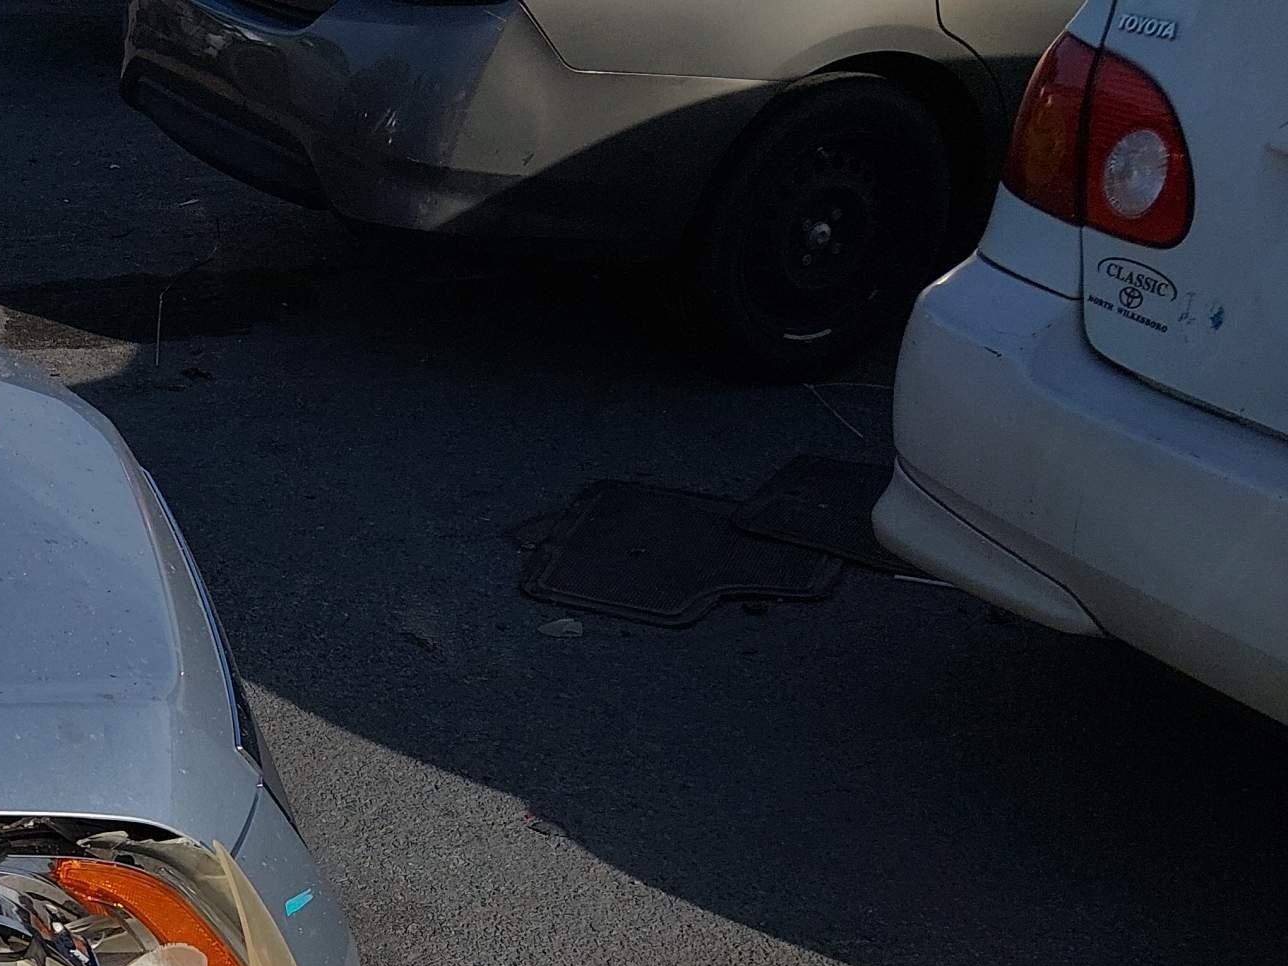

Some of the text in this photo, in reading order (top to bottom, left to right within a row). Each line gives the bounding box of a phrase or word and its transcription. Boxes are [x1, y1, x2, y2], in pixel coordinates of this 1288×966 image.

[1117, 13, 1176, 40] TOYOTA
[1106, 262, 1169, 297] CLASSIC
[1087, 295, 1168, 333] NORTH WILKESBORO
